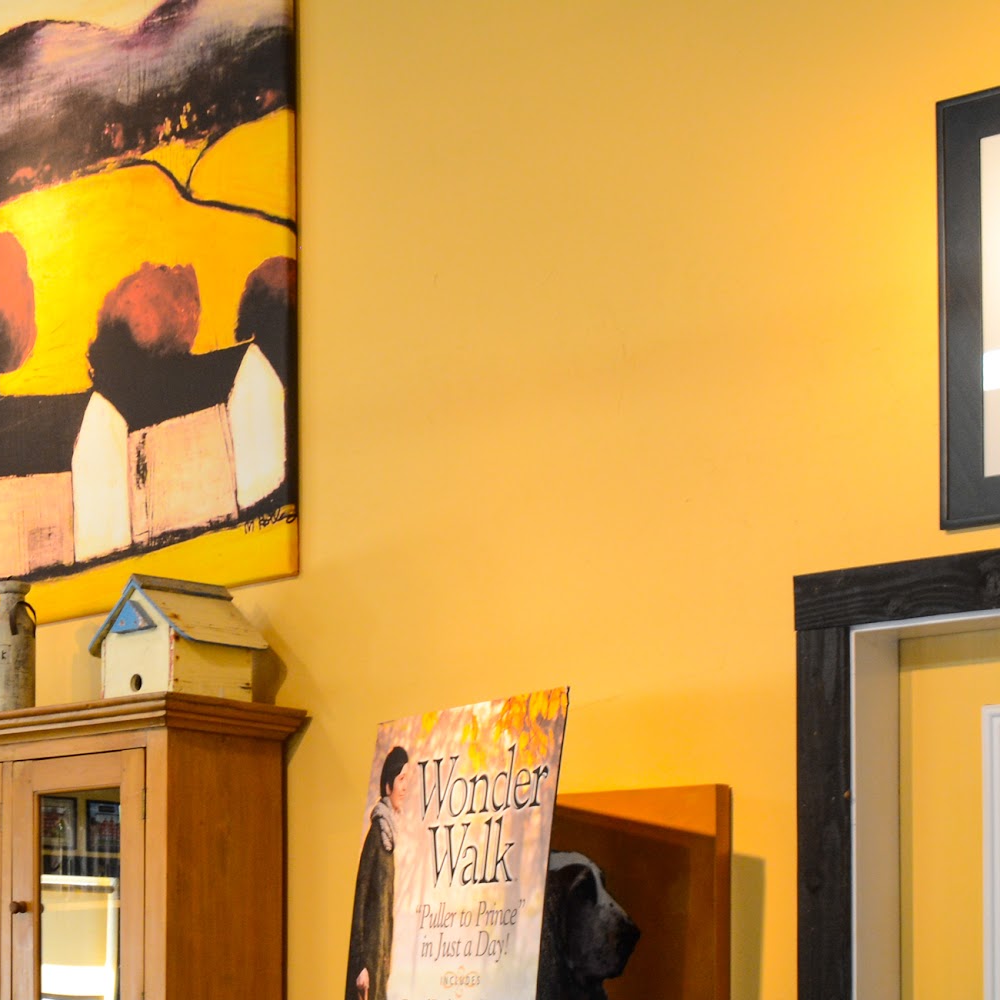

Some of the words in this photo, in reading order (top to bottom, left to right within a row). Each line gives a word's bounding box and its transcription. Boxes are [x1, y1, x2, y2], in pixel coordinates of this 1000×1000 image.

[418, 743, 549, 821] Wonder
[428, 816, 515, 888] Walk
[459, 908, 473, 928] to
[421, 934, 433, 958] in
[434, 932, 462, 961] Just
[463, 939, 473, 957] a
[475, 930, 510, 963] Day!
[441, 975, 481, 986] INCLUDES
